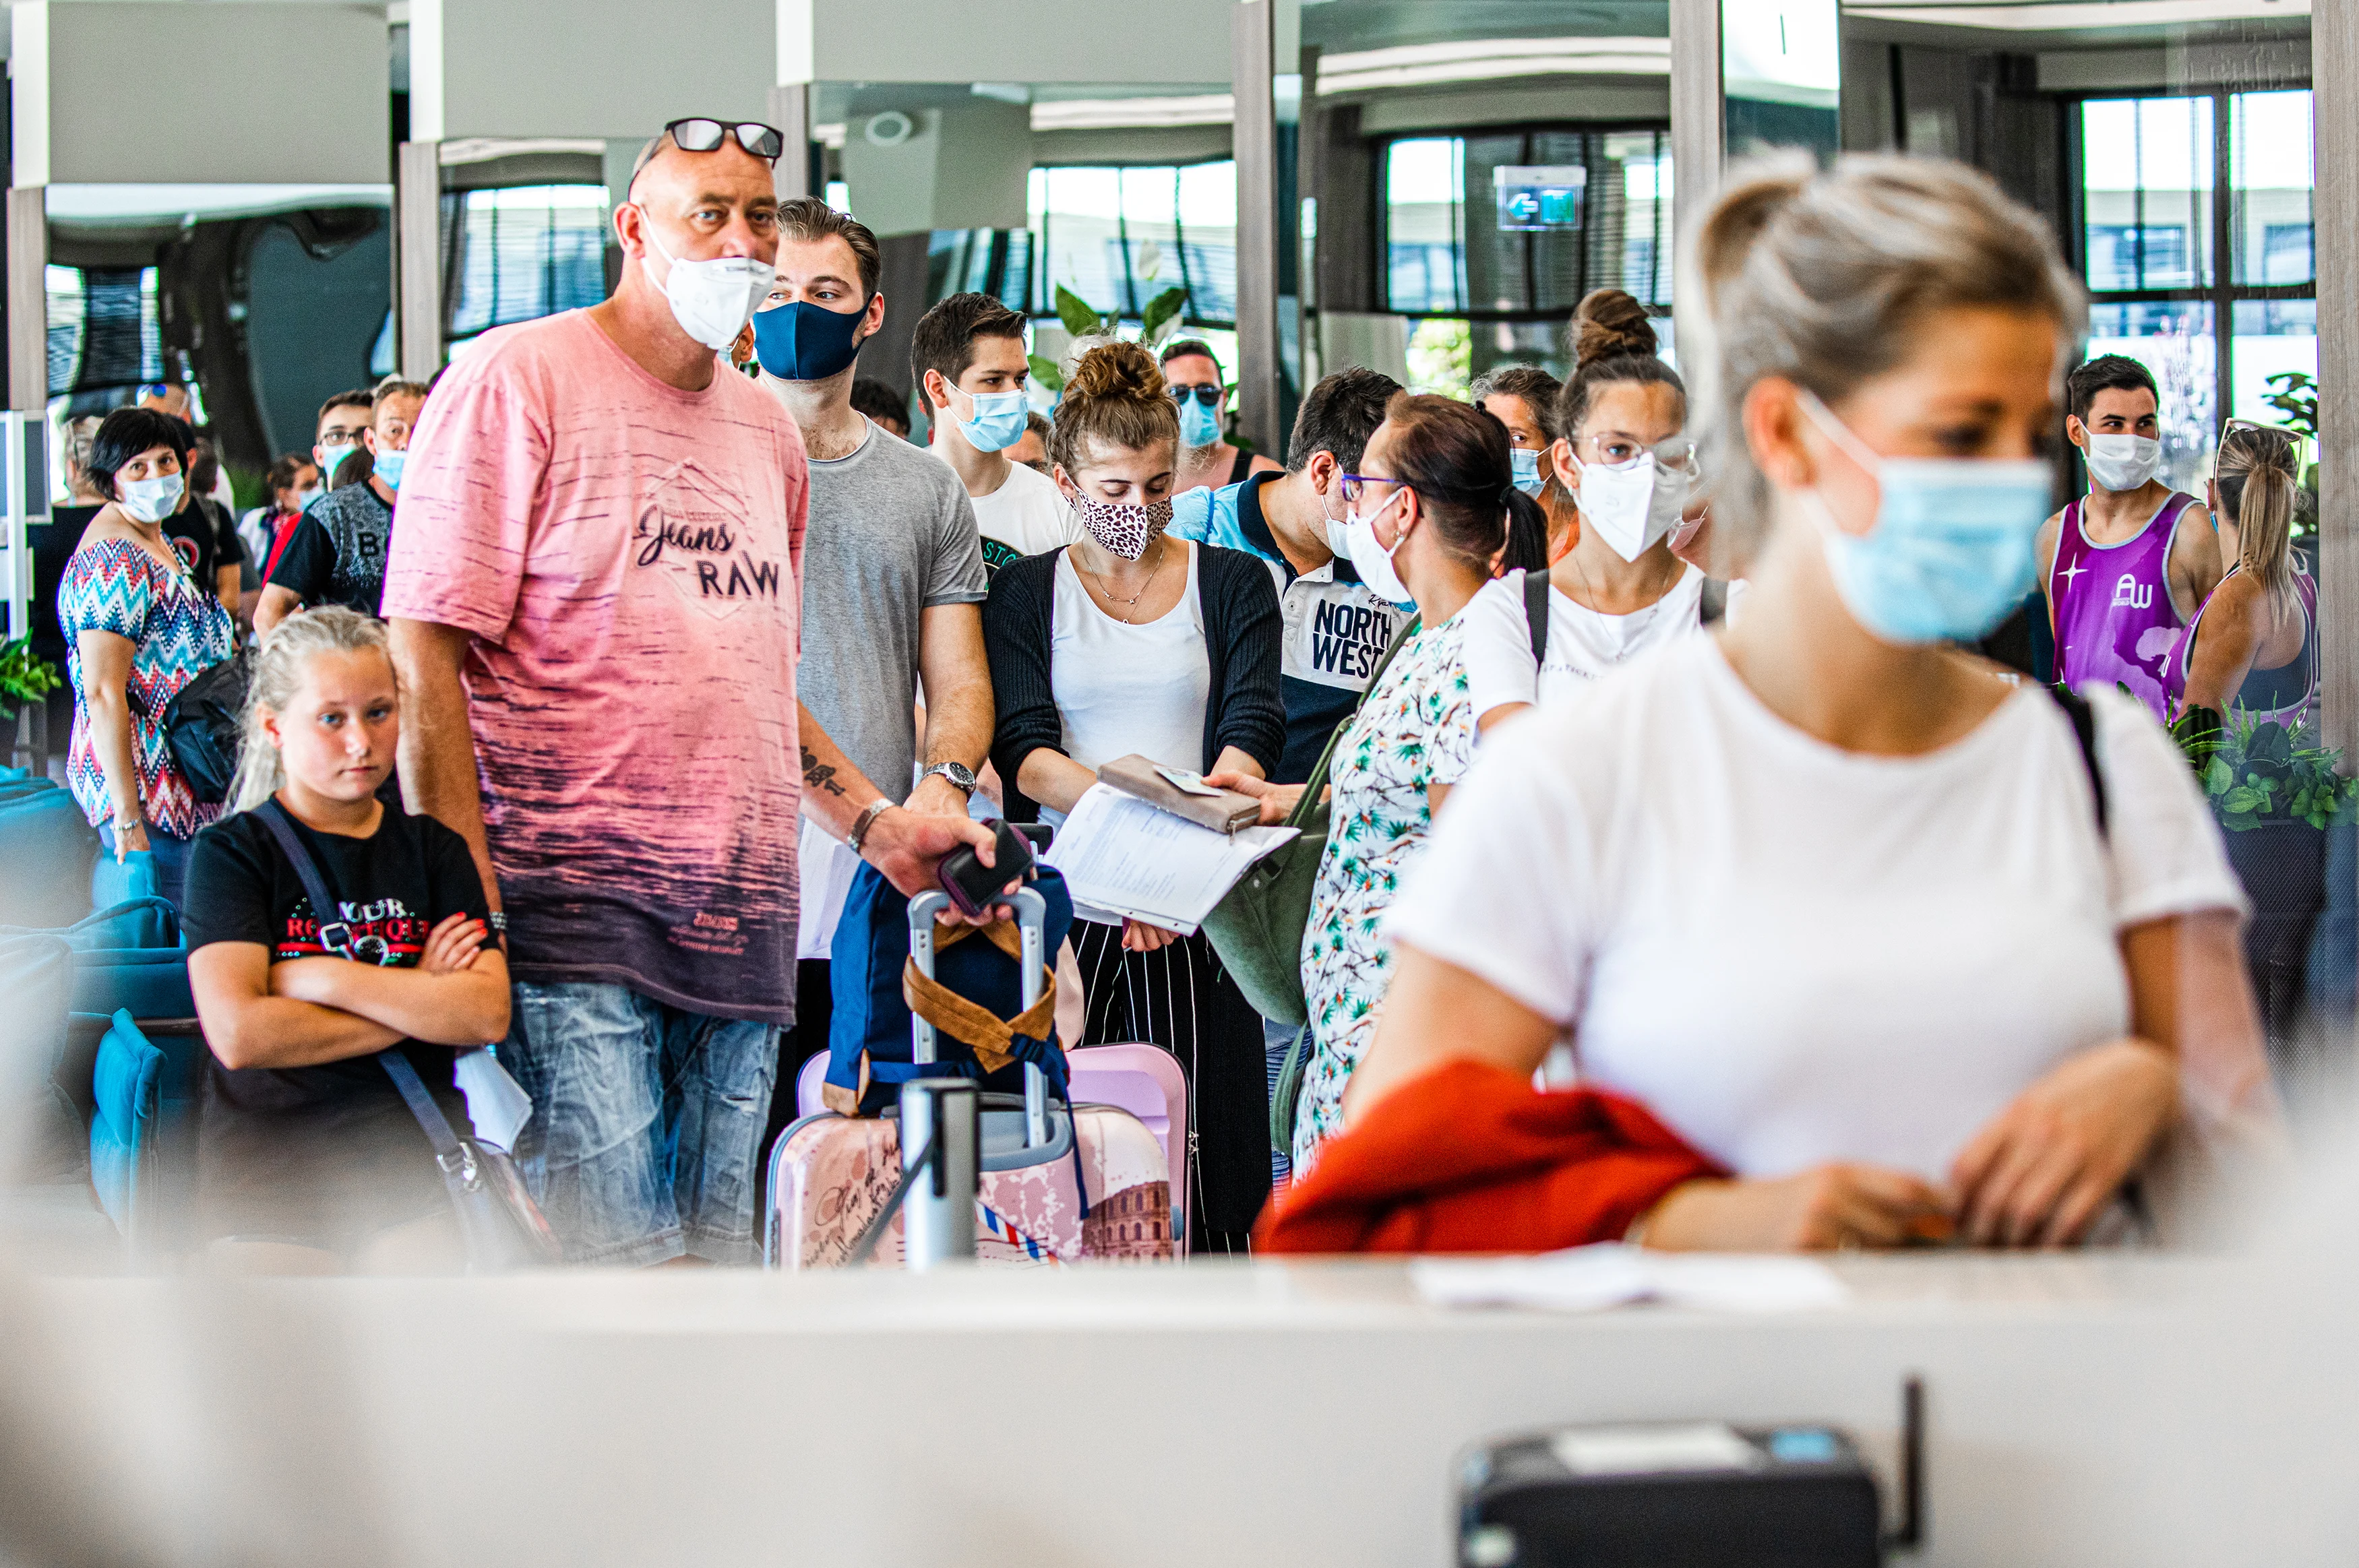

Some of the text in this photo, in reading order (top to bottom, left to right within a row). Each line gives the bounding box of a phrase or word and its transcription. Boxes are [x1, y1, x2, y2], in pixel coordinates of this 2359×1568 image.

[638, 503, 735, 567] Jeans
[696, 550, 779, 598] RAW
[1314, 598, 1391, 650] NORTH
[1313, 632, 1385, 679] WEST
